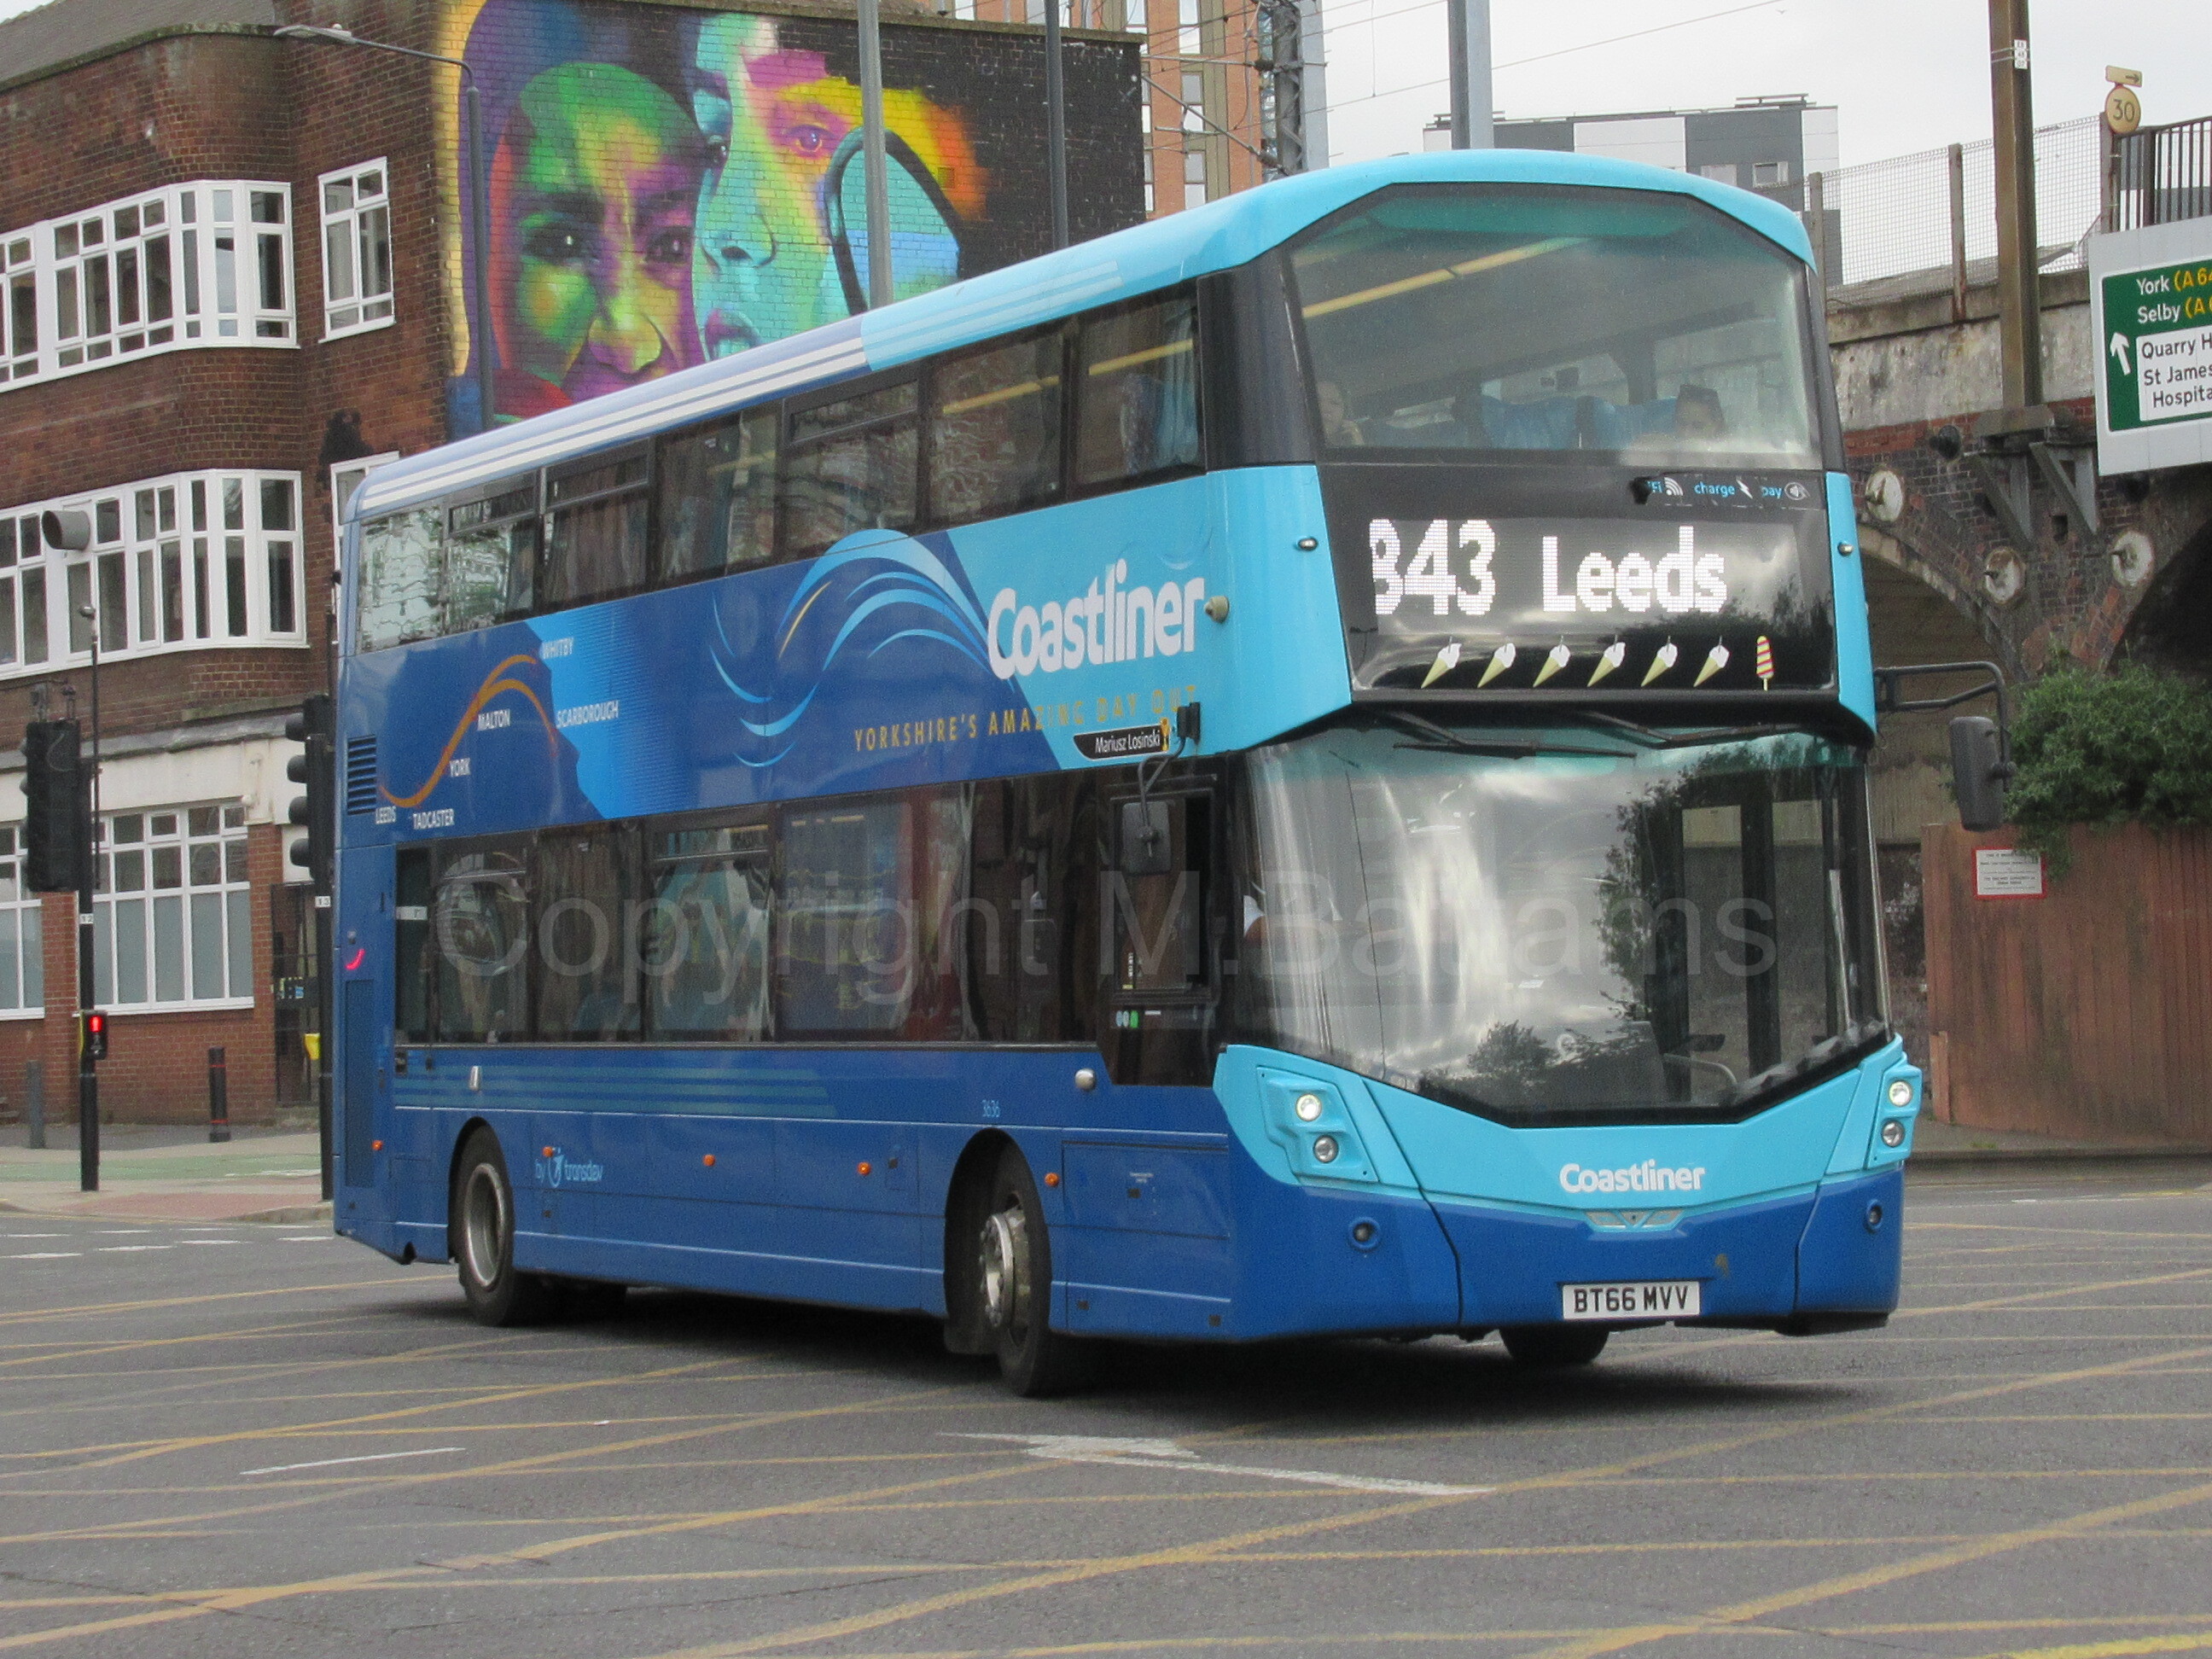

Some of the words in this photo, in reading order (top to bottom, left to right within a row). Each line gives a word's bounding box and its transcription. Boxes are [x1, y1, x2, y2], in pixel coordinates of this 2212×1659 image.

[2112, 98, 2135, 122] 30
[2136, 274, 2170, 296] York
[2137, 302, 2181, 324] Selby
[2142, 339, 2196, 359] Quarry
[2144, 368, 2162, 386] St
[1694, 481, 1736, 498] charge
[1761, 486, 1783, 499] pay
[1542, 525, 1728, 614] Leeds
[987, 557, 1205, 681] Coastliner
[541, 637, 574, 660] WHITBY
[477, 708, 511, 731] MALTON
[556, 700, 620, 729] SCARBOROUGH
[854, 713, 978, 753] YORKSHIRE'S
[988, 700, 1084, 736] AMAZING
[1096, 693, 1138, 723] DAY
[1153, 684, 1196, 715] OUT
[1095, 733, 1126, 754] Mariusz
[1127, 729, 1161, 751] Losinski
[450, 758, 470, 777] YORK
[375, 806, 397, 825] LEEDS
[413, 808, 455, 830] TADCASTER
[1559, 1158, 1705, 1194] Coastliner
[1573, 1287, 1636, 1313] BT66
[1643, 1284, 1689, 1311] MVV
